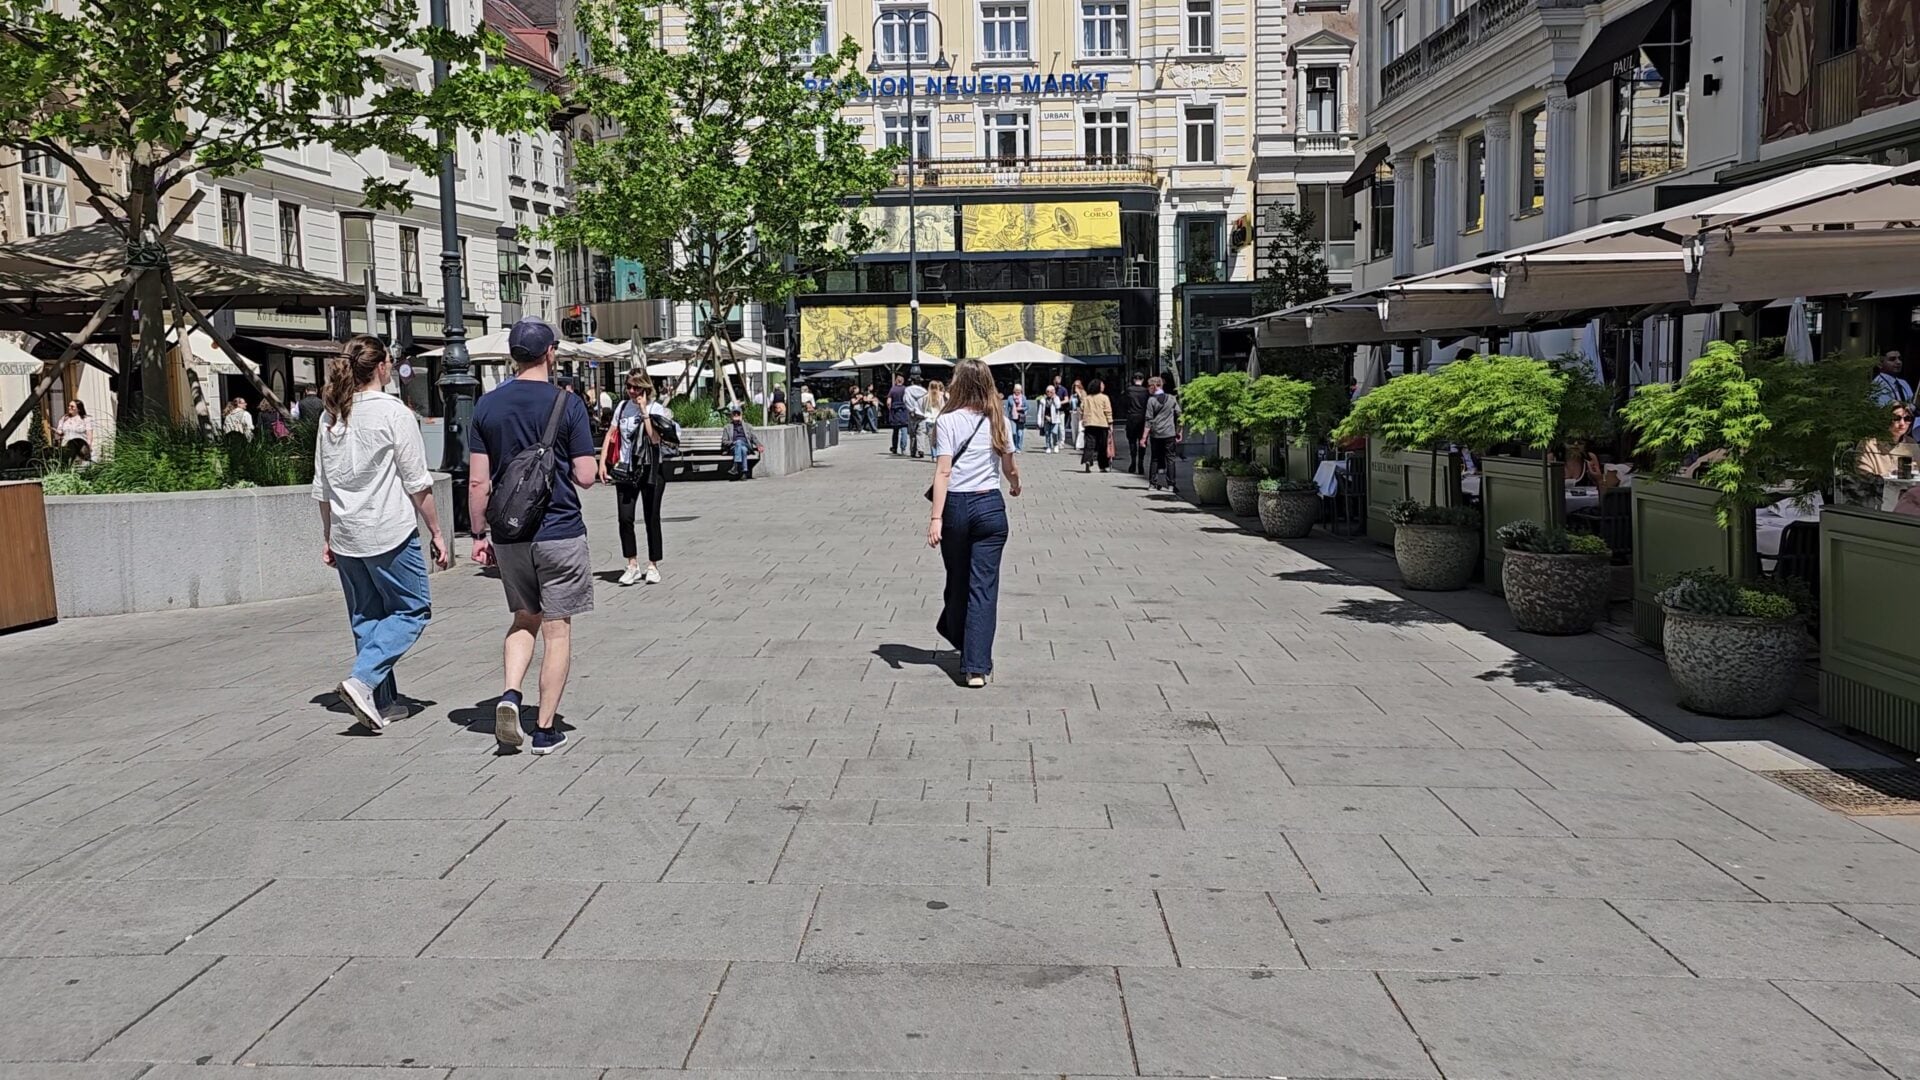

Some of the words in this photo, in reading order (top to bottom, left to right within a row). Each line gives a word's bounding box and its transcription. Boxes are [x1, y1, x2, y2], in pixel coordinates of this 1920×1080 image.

[1612, 55, 1634, 76] PAUL
[804, 77, 914, 97] PEION
[927, 74, 1011, 94] NEUER
[1023, 72, 1109, 94] MARKT
[848, 116, 864, 124] POP
[946, 113, 966, 123] ART
[1043, 112, 1070, 120] URBAN
